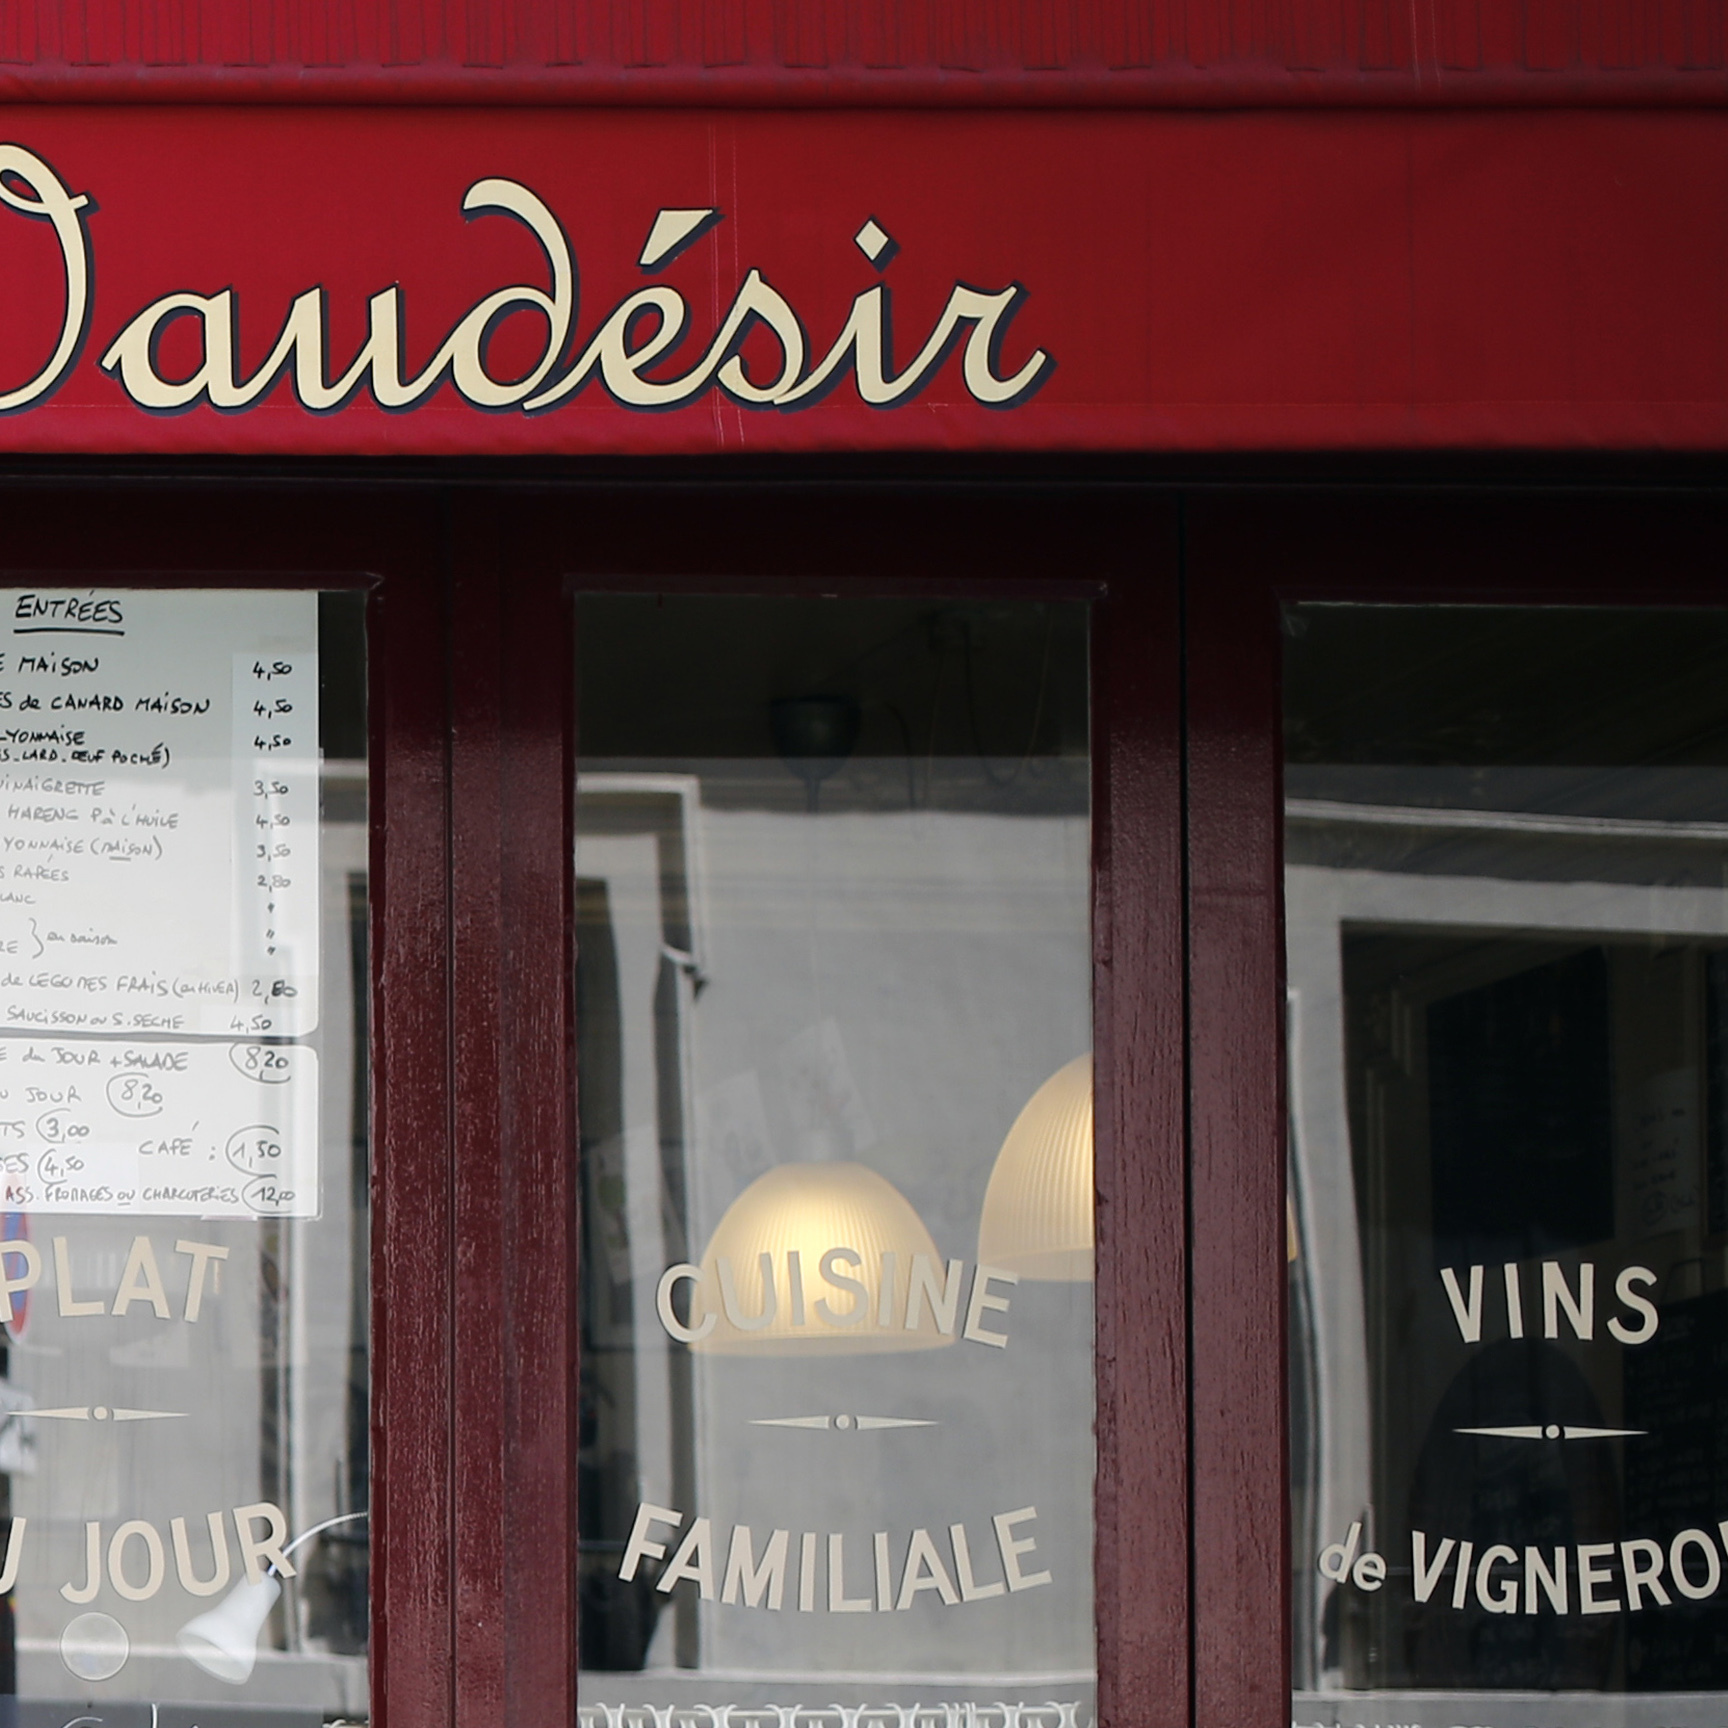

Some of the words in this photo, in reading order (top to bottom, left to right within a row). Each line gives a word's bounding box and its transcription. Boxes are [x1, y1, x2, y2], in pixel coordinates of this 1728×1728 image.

[14, 590, 126, 626] ENTRÉES
[17, 649, 100, 676] MAISON
[252, 660, 294, 681] 4,50
[50, 692, 124, 713] CANARD
[135, 690, 212, 716] MAISON
[252, 698, 294, 719] 4,50
[253, 732, 293, 752] 4,50
[253, 780, 290, 800] 3,50
[255, 813, 291, 830] 4,50
[255, 843, 292, 863] 3,50
[256, 873, 292, 892] 2,80
[229, 1014, 273, 1035] 4,50
[52, 1046, 102, 1069] JOUR
[25, 1084, 83, 1104] JOUR
[655, 1246, 1020, 1350] CUISINE
[1439, 1260, 1660, 1345] VINS
[58, 1501, 298, 1605] JOUR
[617, 1501, 1054, 1614] FAMILIALE
[1317, 1520, 1388, 1592] de
[1410, 1518, 1728, 1617] VIGNERO
